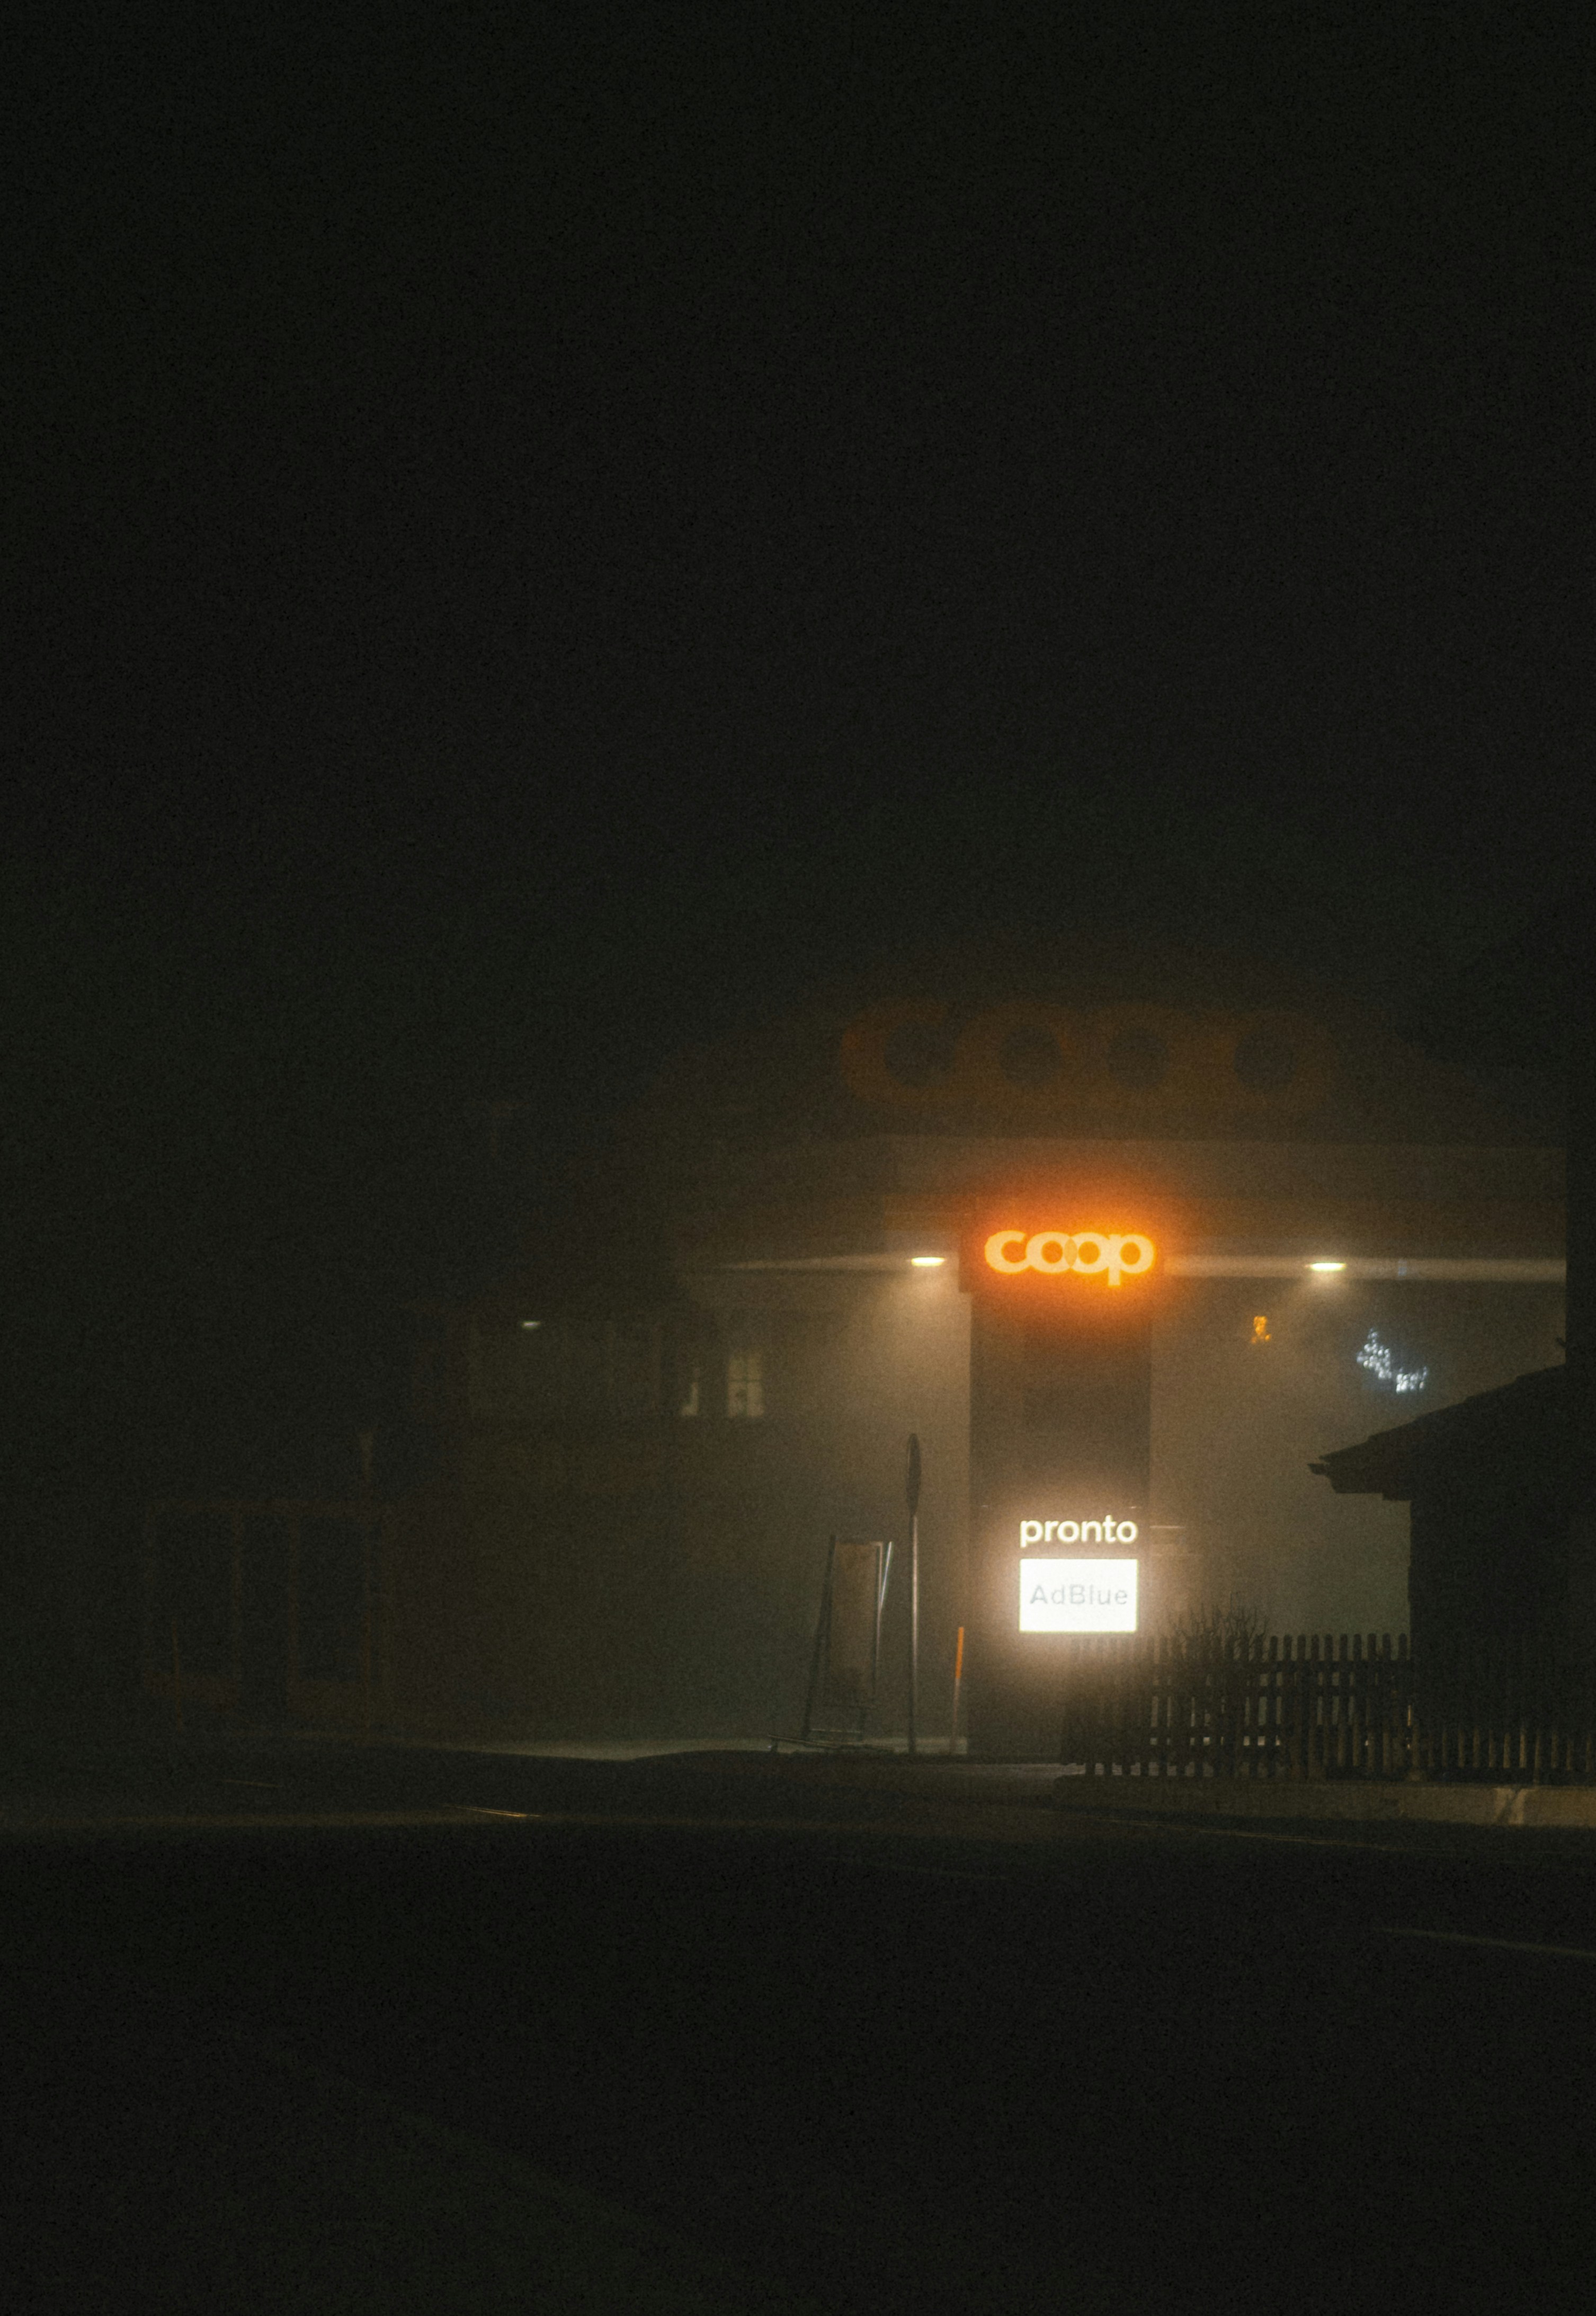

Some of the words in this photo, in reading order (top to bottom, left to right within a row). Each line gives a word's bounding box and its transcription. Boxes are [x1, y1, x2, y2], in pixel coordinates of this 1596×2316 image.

[984, 1230, 1155, 1286] coop
[1020, 1514, 1138, 1548] pronto
[1030, 1584, 1128, 1604] AdBlue
